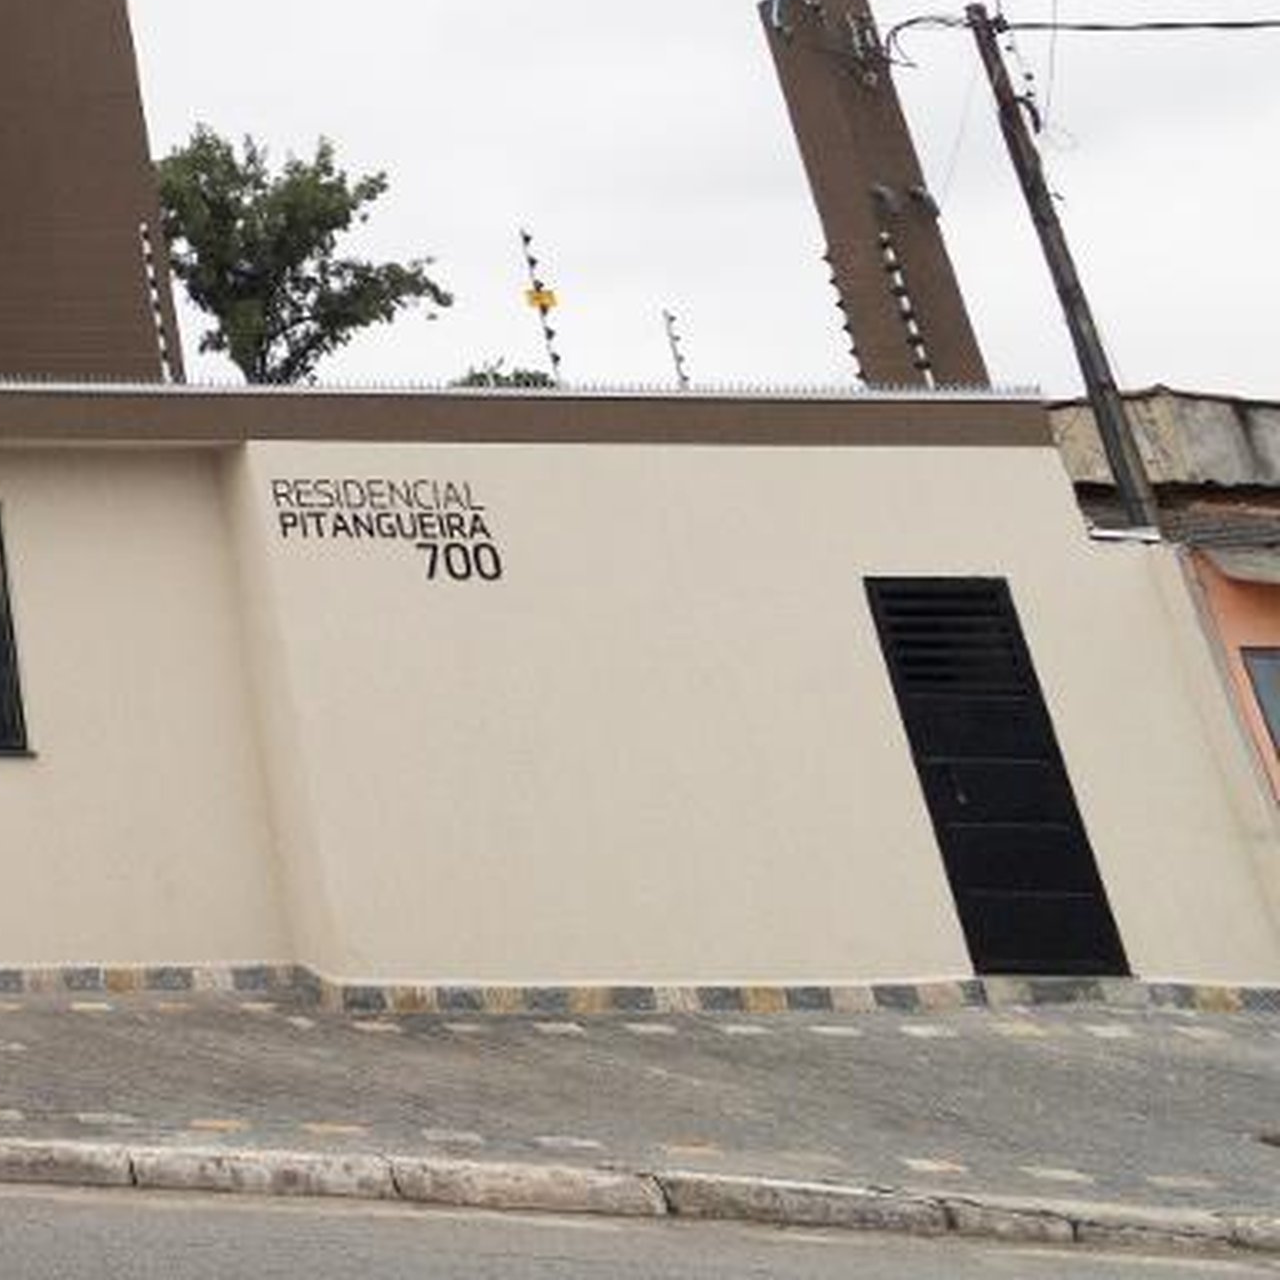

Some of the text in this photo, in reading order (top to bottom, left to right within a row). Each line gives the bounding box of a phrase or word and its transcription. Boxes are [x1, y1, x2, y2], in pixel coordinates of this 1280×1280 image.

[271, 479, 485, 511] RESIDENCIAL
[278, 512, 492, 539] PITANGUEIRA
[416, 543, 502, 580] 700
